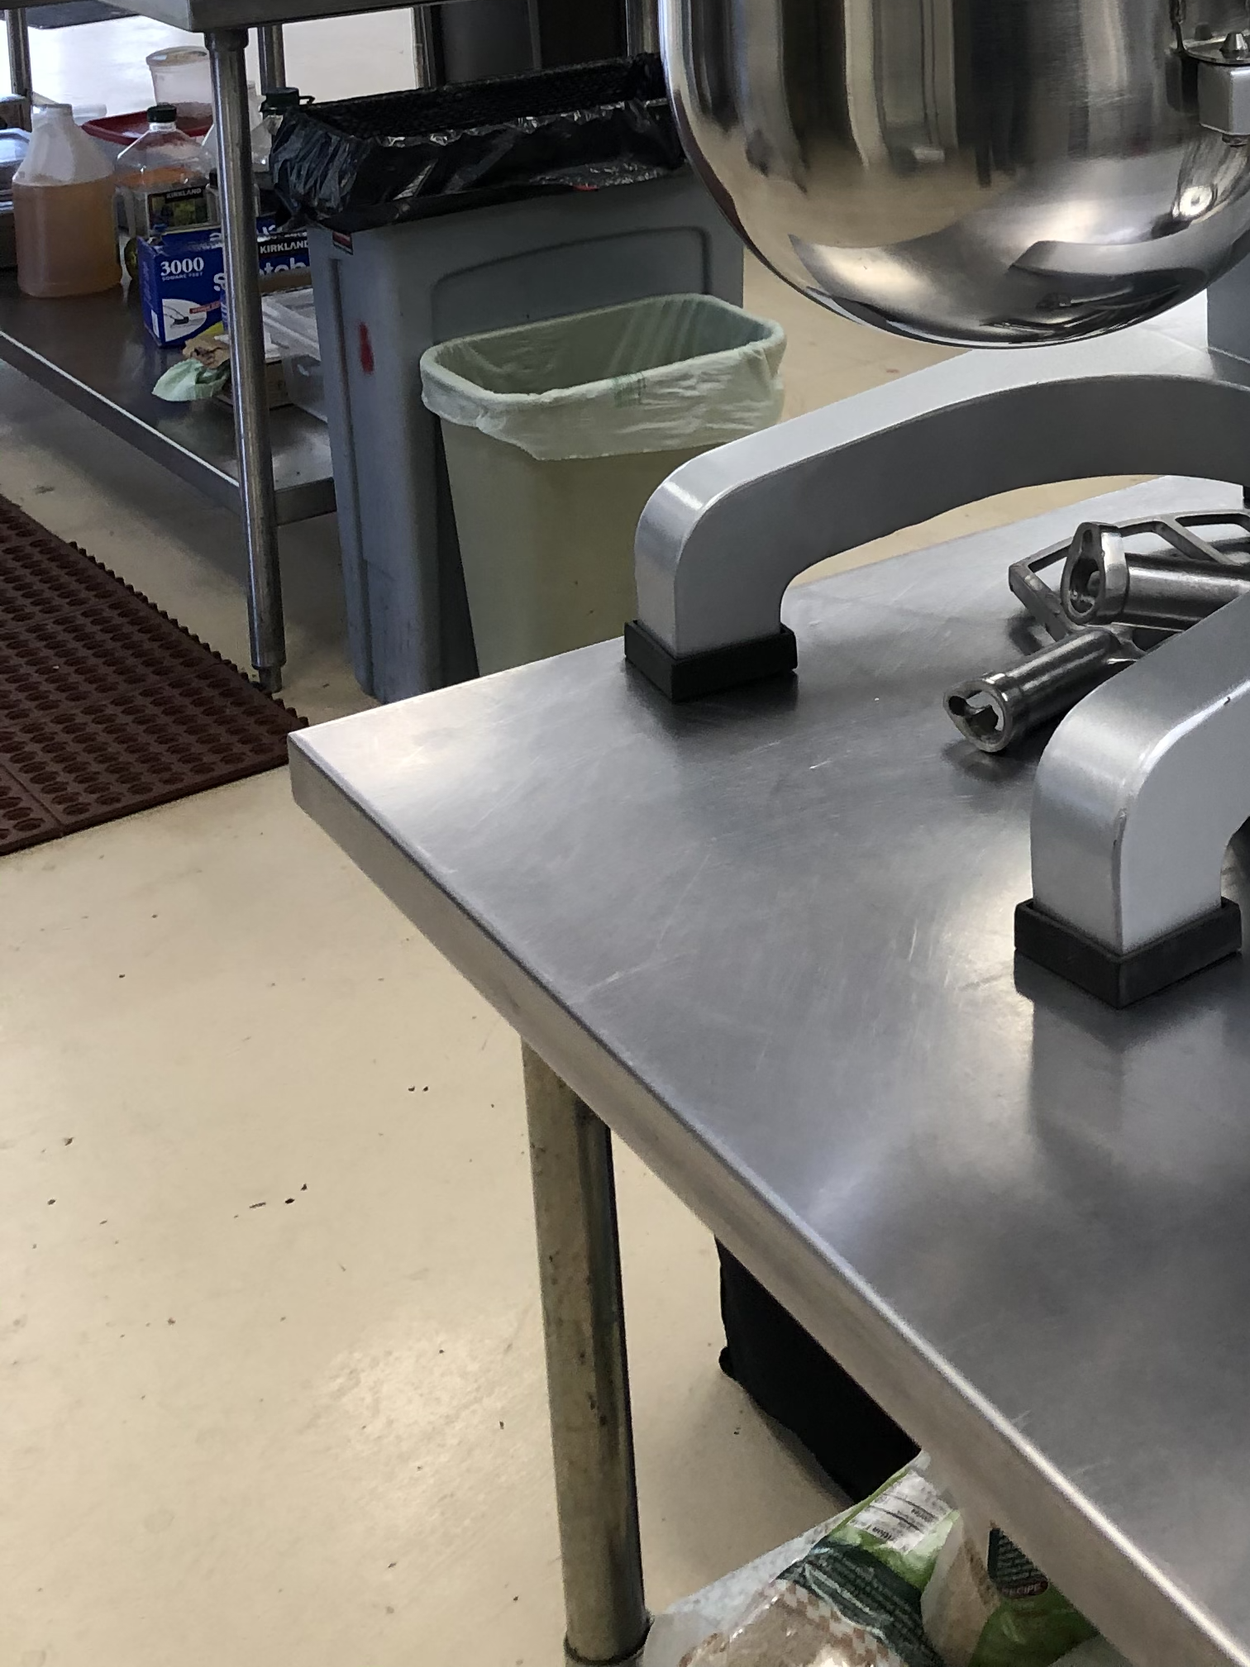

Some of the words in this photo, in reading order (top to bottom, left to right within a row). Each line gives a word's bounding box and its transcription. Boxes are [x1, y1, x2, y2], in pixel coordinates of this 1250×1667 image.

[166, 187, 202, 199] KIRKLAND
[160, 257, 204, 276] 3000
[161, 273, 187, 282] SQUARE
